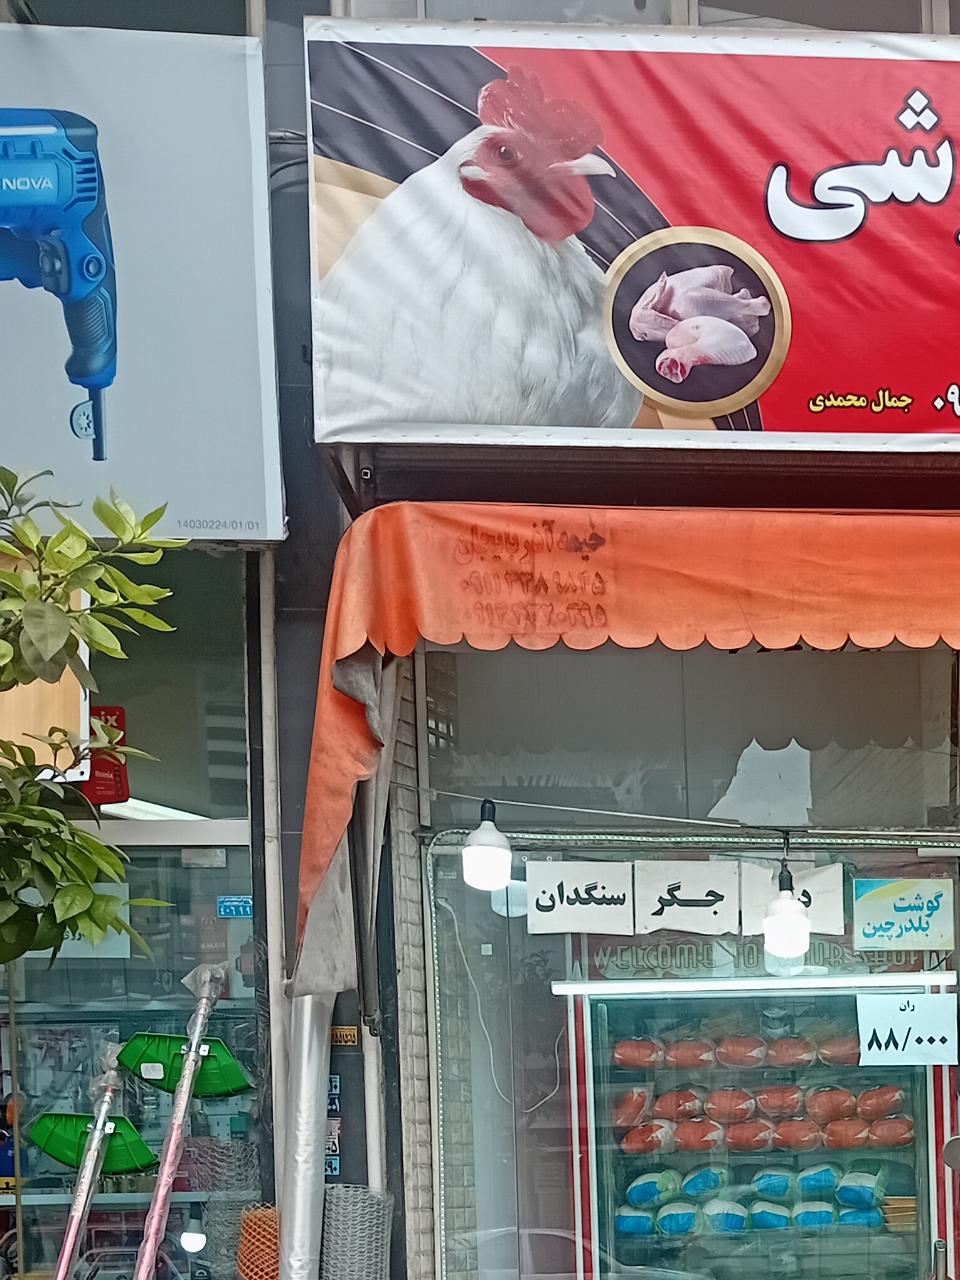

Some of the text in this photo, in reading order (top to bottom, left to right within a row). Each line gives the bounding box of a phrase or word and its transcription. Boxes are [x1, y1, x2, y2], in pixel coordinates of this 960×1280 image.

[2, 177, 54, 190] NOVA
[808, 390, 867, 413] محمدی
[871, 389, 913, 414] جمال
[177, 519, 260, 530] 14030224/01/01
[535, 881, 627, 914] سنگدان
[652, 883, 725, 917] جگر
[892, 890, 945, 916] گوشت
[862, 916, 931, 943] بلدرچین
[594, 943, 717, 969] WELCOME
[899, 999, 916, 1012] ران
[866, 1027, 949, 1053] ۸۸/۰۰۰
